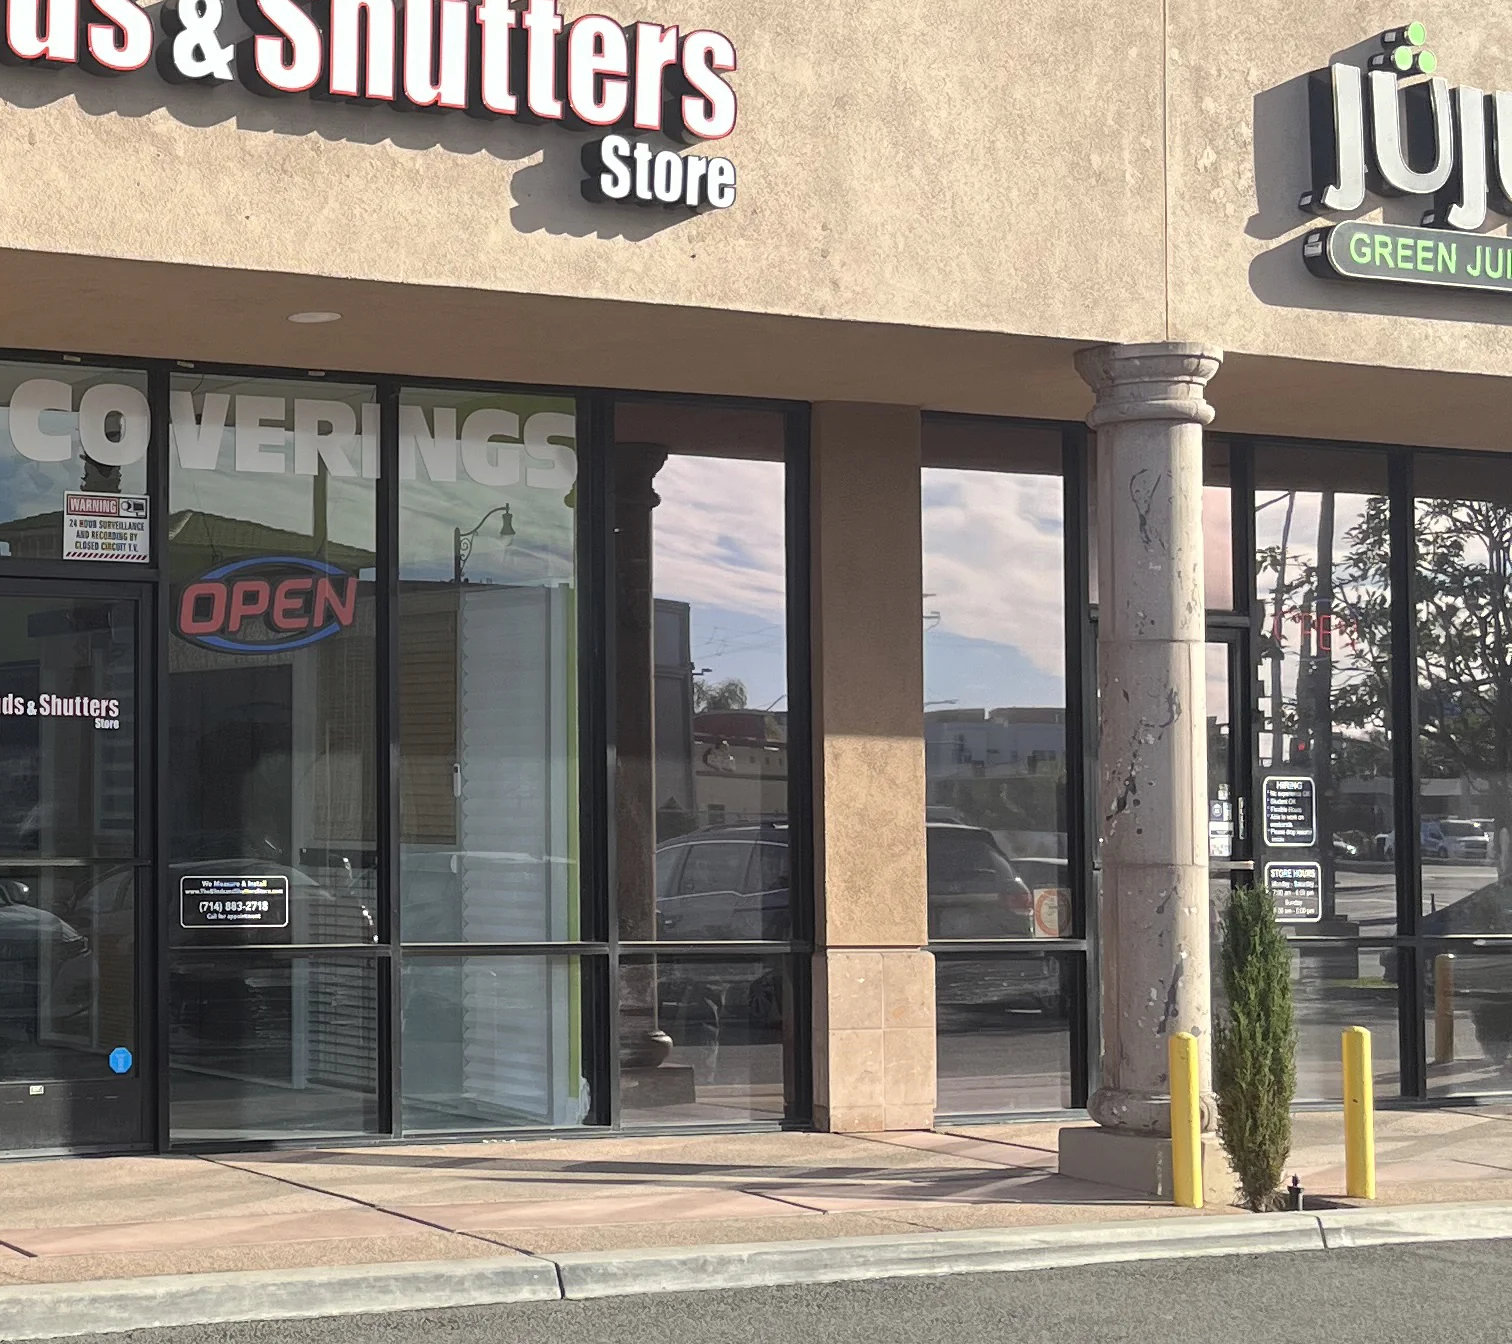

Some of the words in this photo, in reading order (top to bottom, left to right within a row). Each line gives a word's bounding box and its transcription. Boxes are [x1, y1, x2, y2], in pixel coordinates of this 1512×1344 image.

[1322, 62, 1512, 230] JUJ
[600, 134, 737, 209] Store
[1349, 232, 1457, 274] GREEN
[7, 378, 578, 489] COVERINGS
[70, 497, 117, 514] WARNING
[69, 519, 78, 528] 24
[79, 519, 97, 529] HOUR
[99, 520, 145, 531] SURVEILLANCE
[76, 530, 90, 539] AND
[91, 530, 128, 541] RECORDING
[129, 532, 138, 542] BY
[74, 540, 99, 551] CLOSED
[101, 541, 126, 552] CIRCUIT
[178, 577, 358, 635] OPEN
[26, 700, 37, 716] &
[39, 693, 119, 718] Shutters
[94, 718, 120, 729] Store
[1276, 781, 1303, 790] HIRING
[1270, 868, 1292, 878] STORE
[1293, 868, 1316, 878] HOURS
[248, 879, 268, 887] Install
[199, 901, 223, 913] (714)
[225, 900, 269, 912] 883-2718
